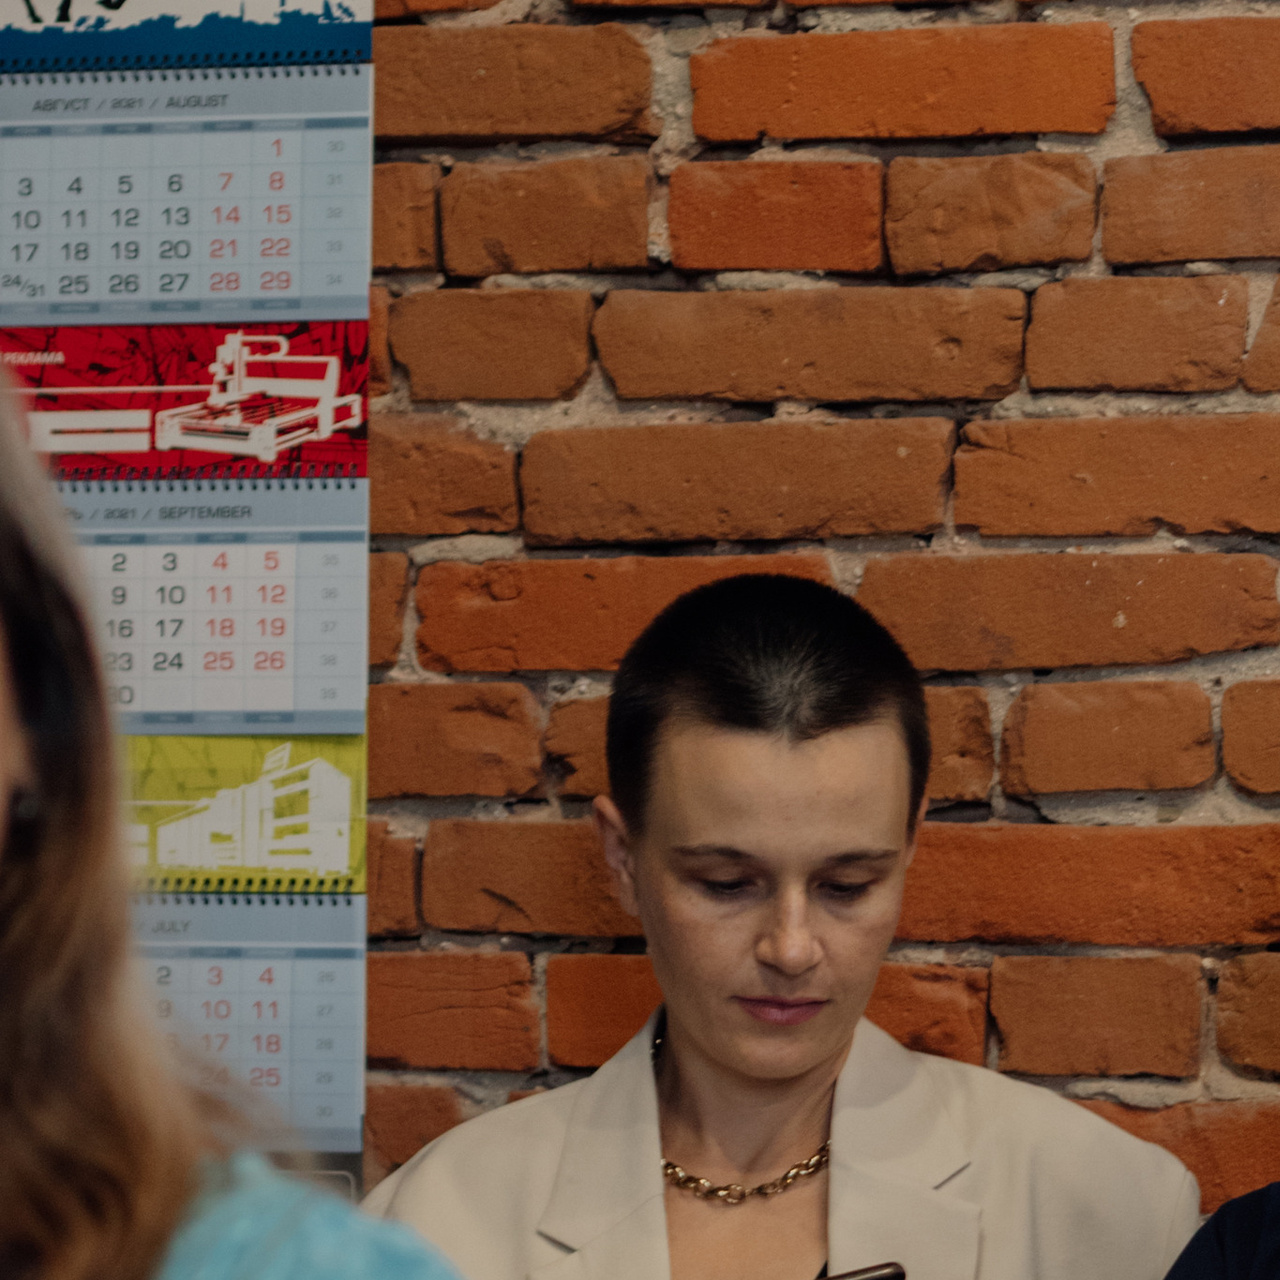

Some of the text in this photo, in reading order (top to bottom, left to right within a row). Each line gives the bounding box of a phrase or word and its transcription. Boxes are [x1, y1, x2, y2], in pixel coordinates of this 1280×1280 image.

[32, 97, 91, 113] АВГУСТ
[165, 94, 229, 109] AUGUST
[271, 138, 284, 158] 1
[18, 177, 33, 196] 3
[67, 176, 84, 195] 4
[117, 175, 134, 194] 5
[167, 174, 184, 193] 6
[218, 172, 235, 191] 7
[269, 171, 285, 191] 8
[11, 210, 41, 229] 10
[61, 209, 88, 228] 11
[111, 208, 140, 228] 12
[161, 206, 190, 226] 13
[211, 205, 241, 225] 14
[263, 204, 293, 224] 15
[11, 243, 39, 262] 17
[60, 242, 90, 261] 18
[110, 241, 140, 261] 19
[159, 239, 192, 259] 20
[209, 238, 238, 258] 21
[260, 237, 291, 257] 22
[58, 275, 90, 295] 25
[108, 274, 140, 294] 26
[159, 273, 190, 293] 27
[209, 272, 241, 292] 28
[260, 271, 292, 291] 29
[158, 505, 252, 520] SEPTEMBER
[111, 553, 127, 572] 2
[162, 553, 178, 572] 3
[212, 551, 229, 570] 4
[264, 551, 280, 570] 5
[111, 586, 127, 605] 9
[155, 585, 186, 605] 10
[206, 585, 233, 604] 11
[257, 584, 287, 604] 12
[106, 619, 134, 638] 16
[155, 618, 184, 638] 17
[205, 618, 235, 637] 18
[256, 617, 286, 637] 19
[153, 652, 183, 671] 24
[203, 651, 235, 671] 25
[253, 650, 285, 670] 26
[156, 965, 172, 985] 2
[207, 966, 224, 986] 3
[258, 966, 275, 985] 4
[201, 999, 232, 1019] 10
[252, 1000, 279, 1019] 11
[201, 1033, 230, 1052] 17
[252, 1033, 282, 1053] 18
[249, 1067, 281, 1087] 25
